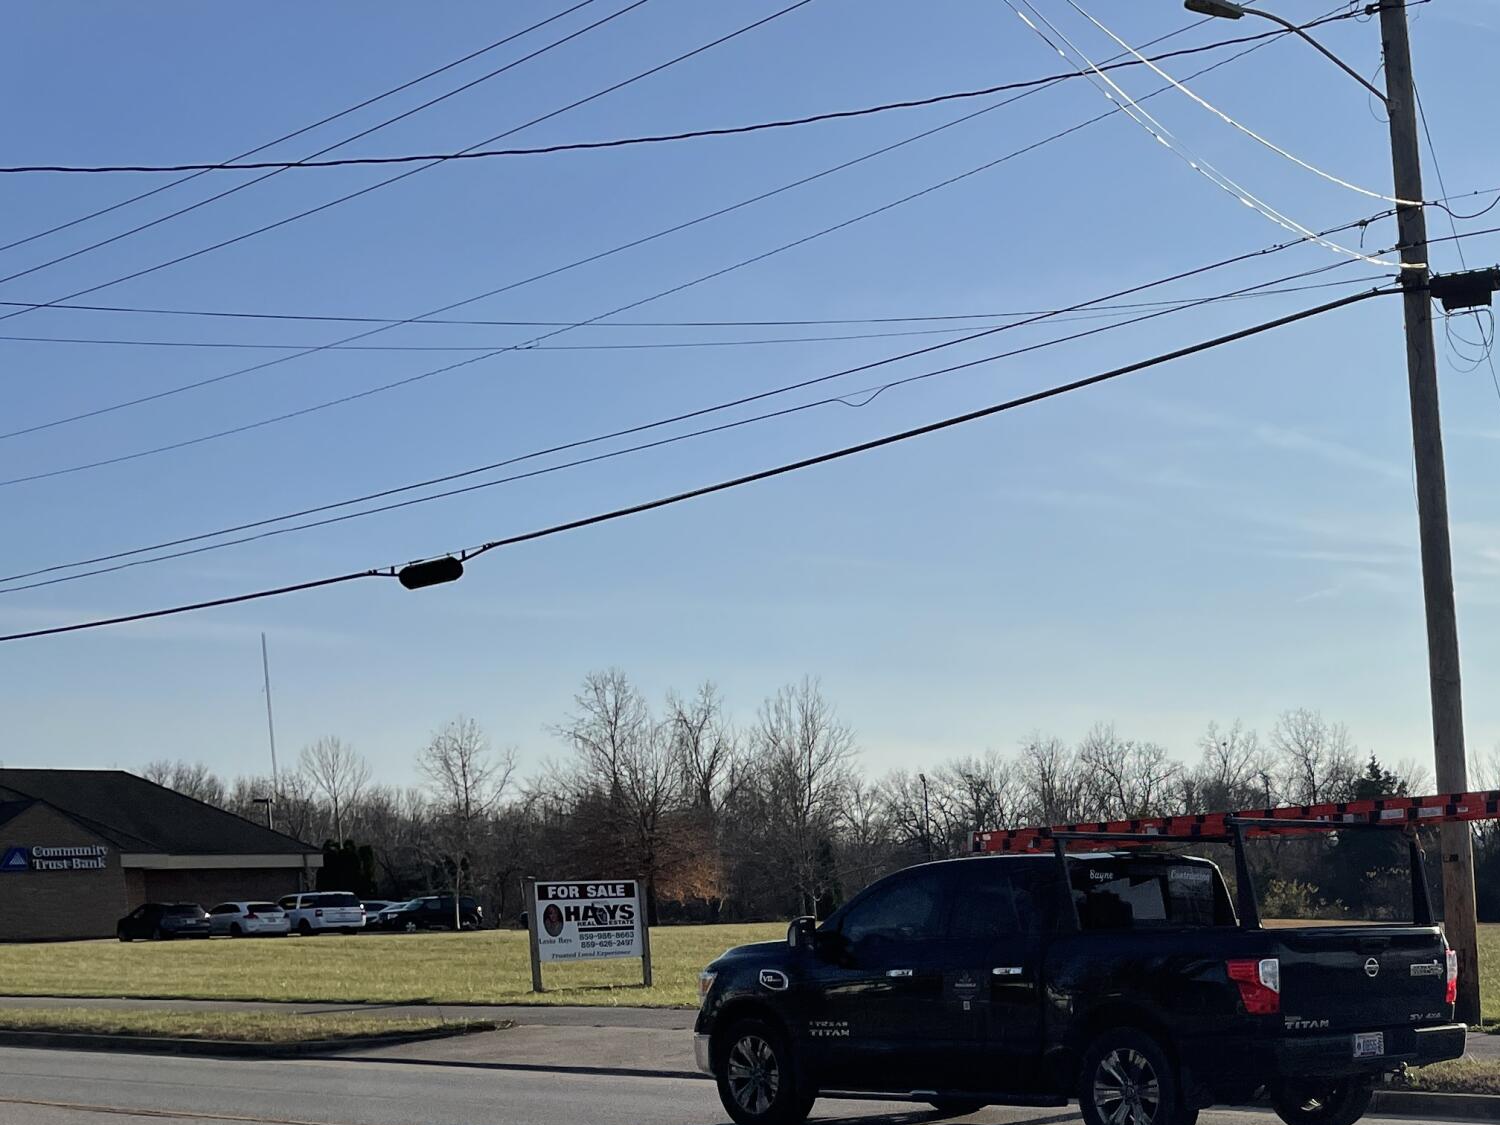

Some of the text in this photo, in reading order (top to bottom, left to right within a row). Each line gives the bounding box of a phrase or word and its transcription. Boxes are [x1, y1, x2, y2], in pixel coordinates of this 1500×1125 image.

[32, 845, 107, 857] Community
[33, 857, 106, 869] Trust Bank
[547, 884, 626, 898] FOR SALE
[564, 903, 635, 922] HAYS
[1284, 1019, 1329, 1030] TITAN
[809, 1029, 850, 1037] TITAN
